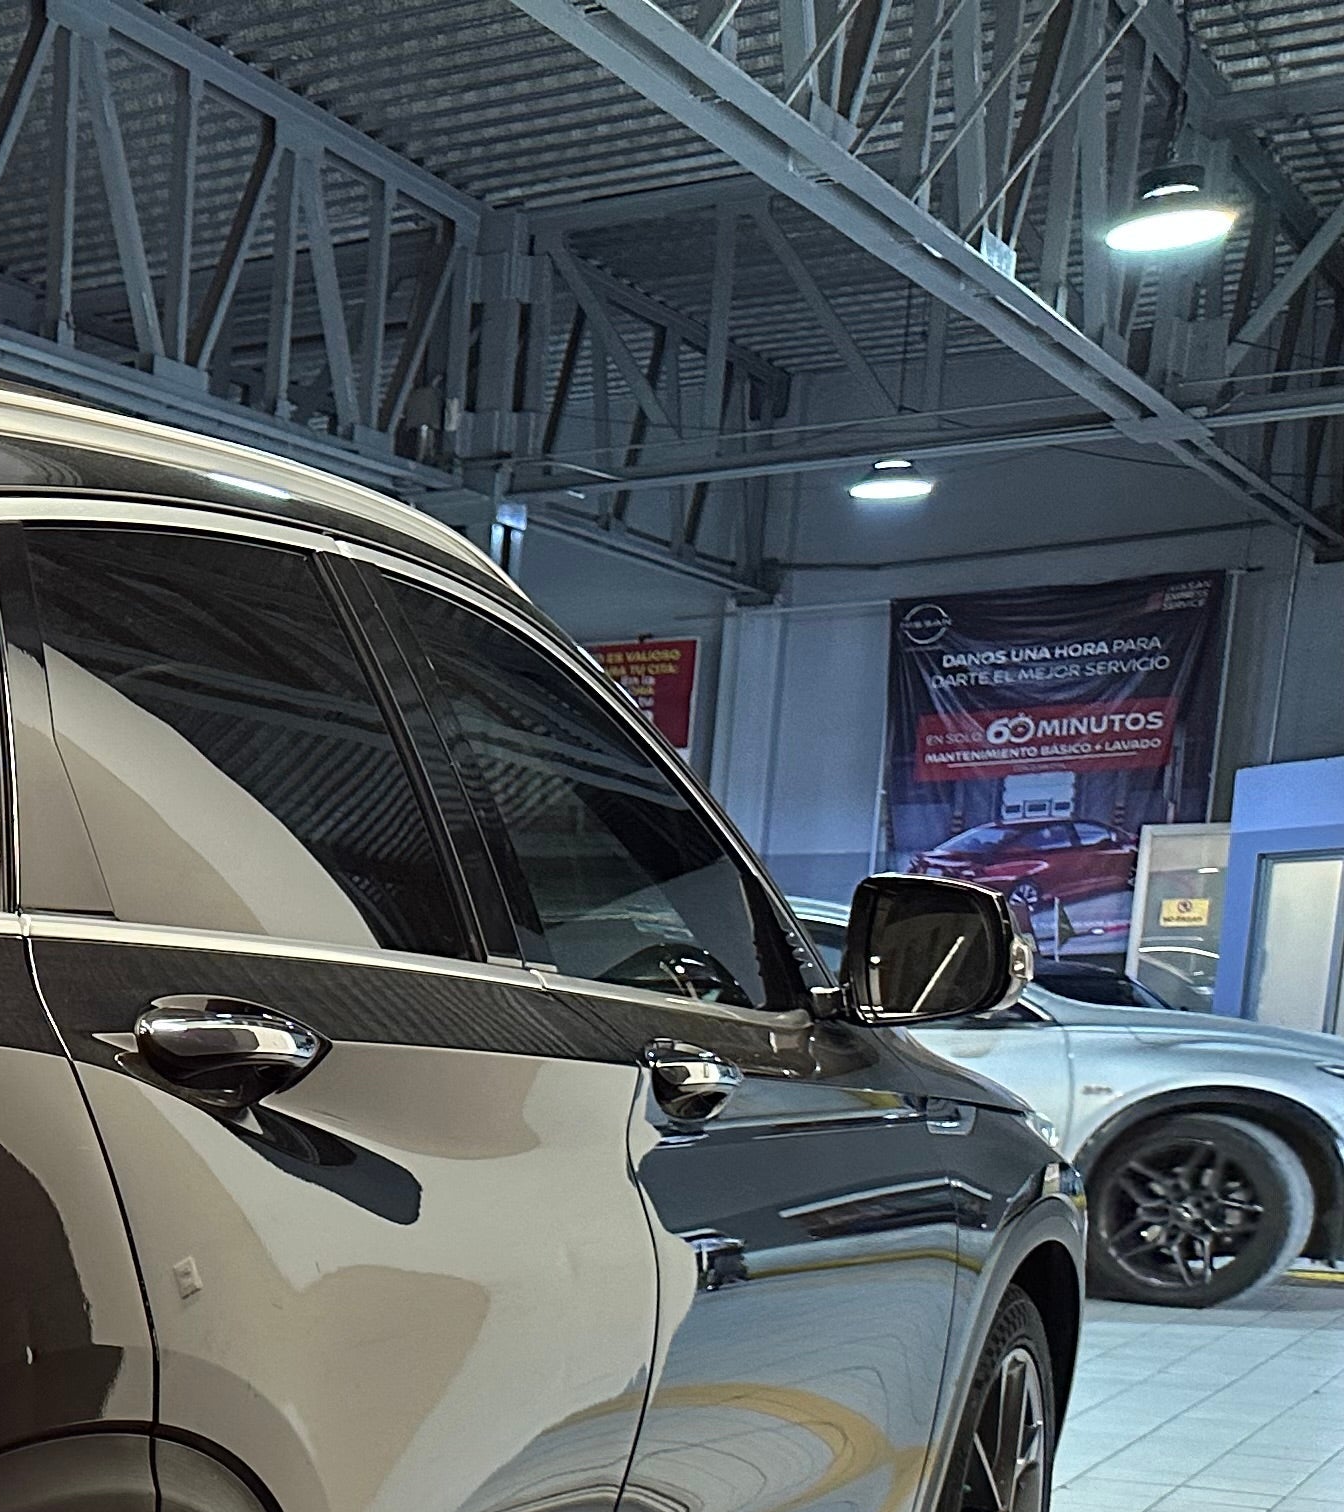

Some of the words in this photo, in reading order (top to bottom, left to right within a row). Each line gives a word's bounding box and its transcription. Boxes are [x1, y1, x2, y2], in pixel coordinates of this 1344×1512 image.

[1011, 646, 1051, 662] UNA
[1054, 640, 1110, 658] HORA
[1112, 636, 1162, 653] PARA
[930, 672, 991, 689] DARTE
[993, 669, 1016, 684] EL
[1017, 664, 1081, 681] MEJOR
[1083, 656, 1171, 677] SERVICIO
[925, 734, 944, 747] EN
[945, 731, 984, 745] SOLO
[986, 714, 1036, 744] 60
[1036, 711, 1164, 738] MINUTOS
[924, 746, 1038, 764] MANTENIMIENTO
[1104, 738, 1162, 752] LAVADO
